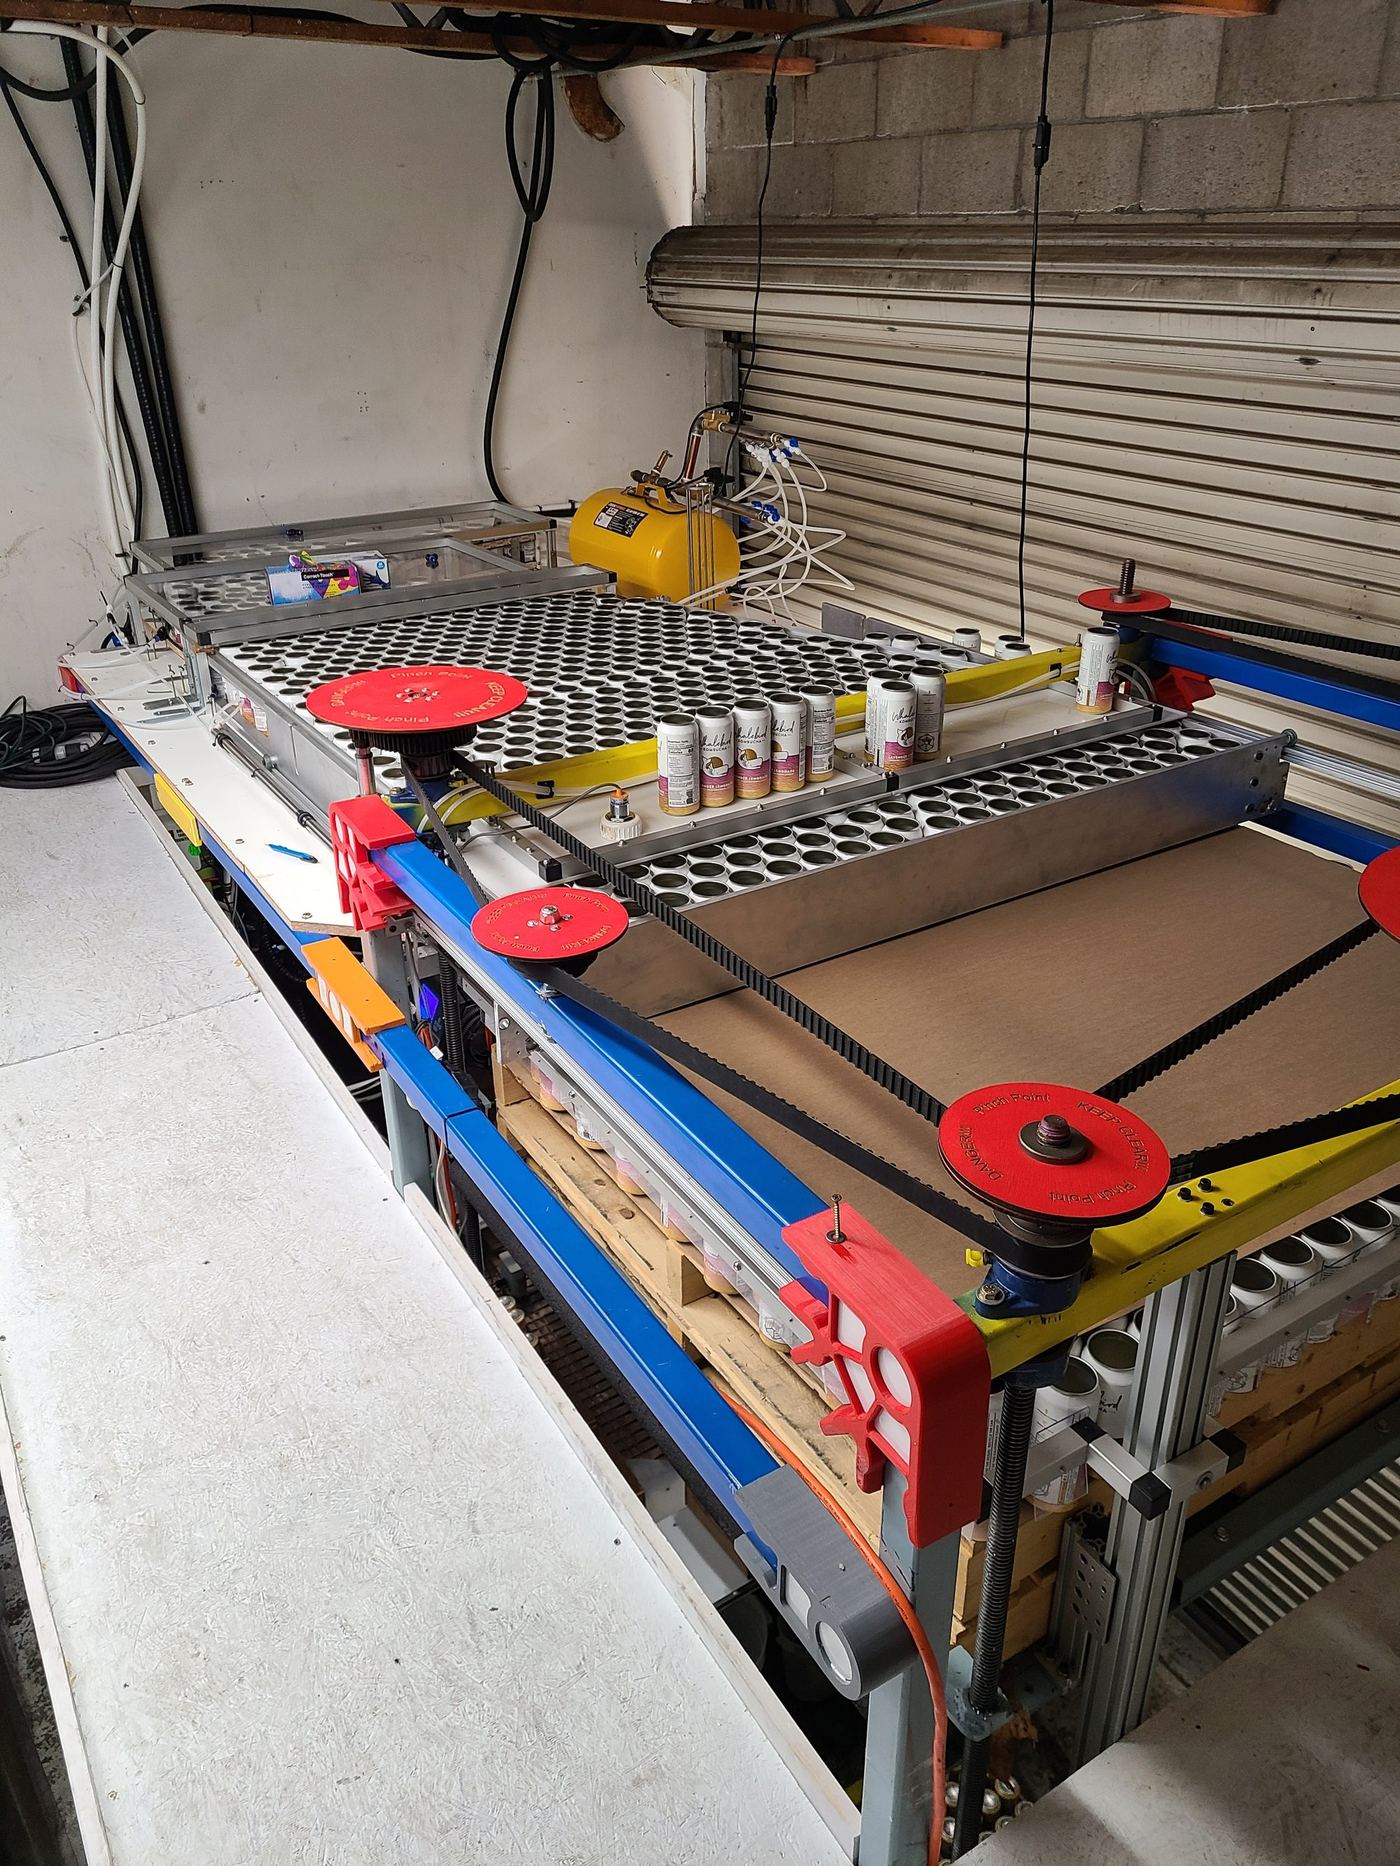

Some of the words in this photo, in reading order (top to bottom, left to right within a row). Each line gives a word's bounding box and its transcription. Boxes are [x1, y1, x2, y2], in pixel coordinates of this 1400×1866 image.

[972, 1095, 1009, 1116] Pinch
[1011, 1092, 1051, 1104] Point
[1077, 1100, 1122, 1125] KEEP
[1049, 1190, 1094, 1205] Point
[1095, 1179, 1137, 1202] Pinch
